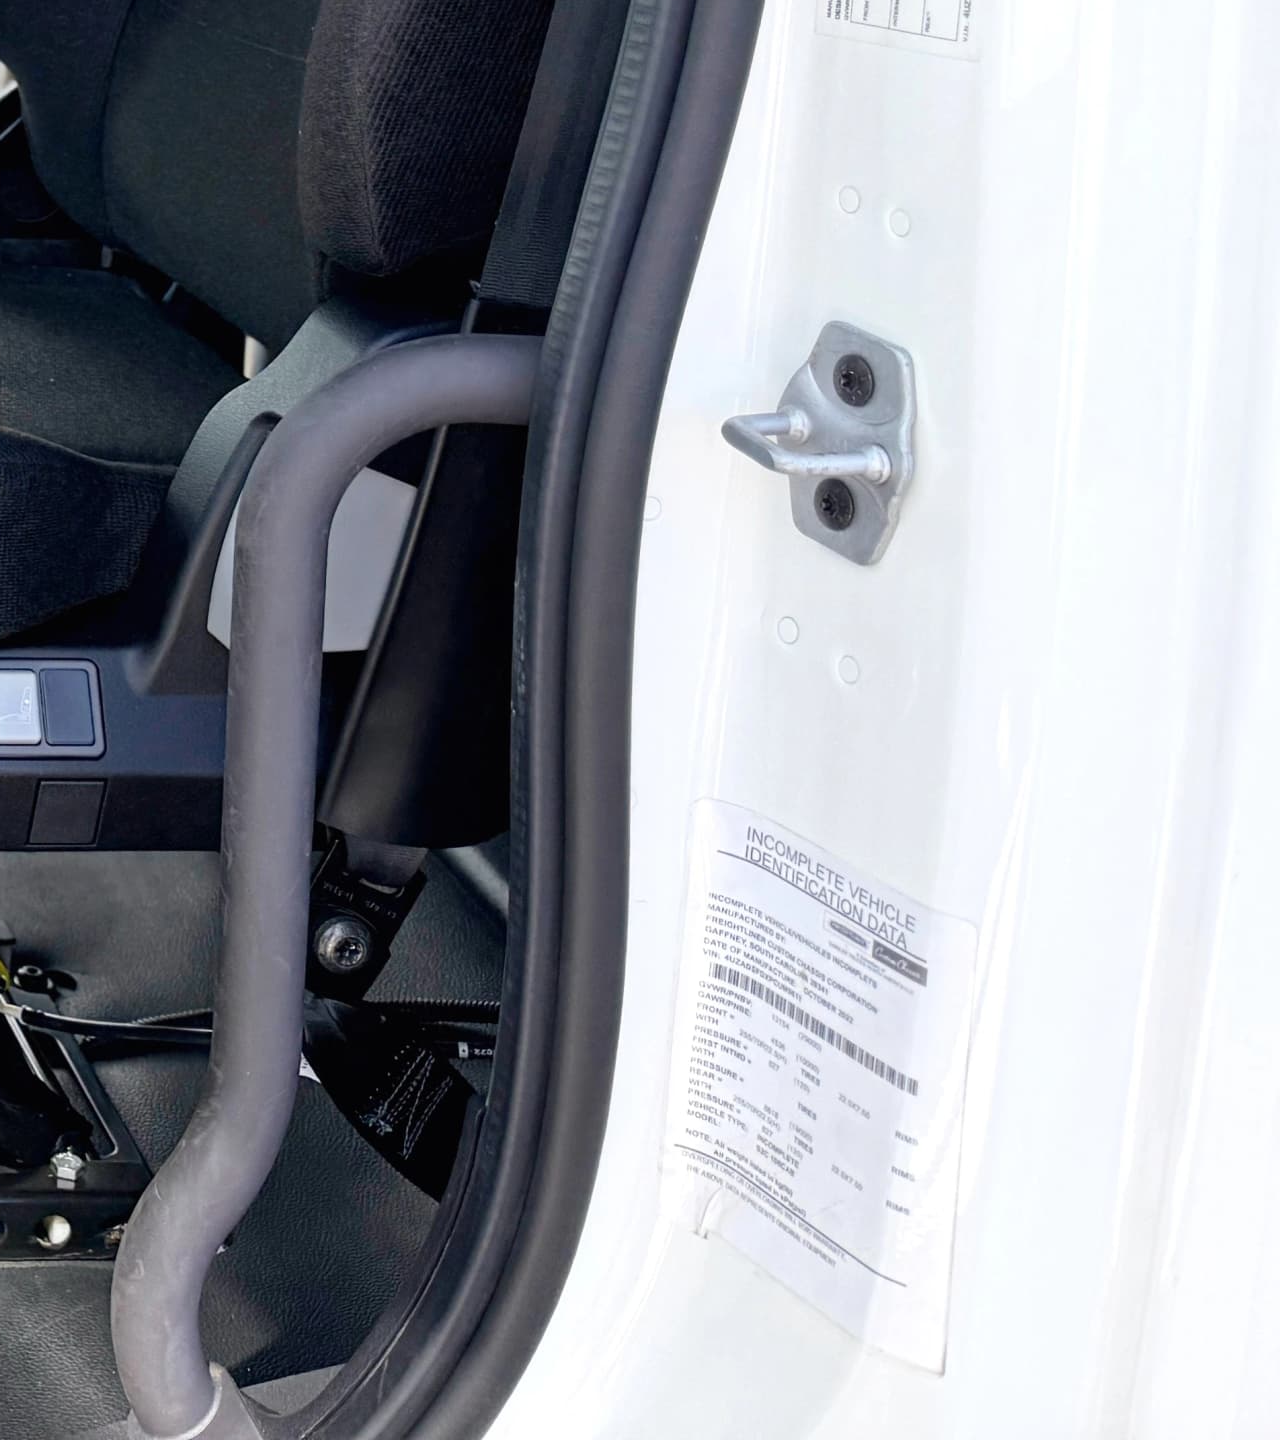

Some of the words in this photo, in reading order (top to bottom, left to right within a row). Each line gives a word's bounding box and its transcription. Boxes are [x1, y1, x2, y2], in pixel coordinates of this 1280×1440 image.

[746, 825, 844, 892] INCOMPLETE
[848, 880, 916, 933] VEHICLE
[708, 891, 762, 918] INCOMPLETE
[744, 843, 863, 923] IDENTIFICATION
[867, 912, 908, 949] DATA
[707, 902, 773, 937] MANUFACTURED
[705, 924, 747, 948] GAFFNEY,
[749, 940, 773, 960] SOUTH
[774, 955, 808, 982] CAROLINA
[705, 914, 766, 944] FREIGHTLINER
[767, 938, 795, 963] CUSTOM
[796, 957, 825, 982] CHASSIS
[826, 976, 878, 1014] CORPORATION
[703, 936, 727, 950] DATE
[729, 945, 742, 956] OF
[803, 986, 836, 1013] OCTOBER
[695, 1011, 718, 1026] WITH
[696, 1001, 728, 1017] FRONT
[694, 1024, 741, 1049] PRESSURE
[690, 1056, 737, 1081] PRESSURE
[687, 1098, 724, 1118] VEHICLE
[688, 1087, 734, 1112] PRESSURE
